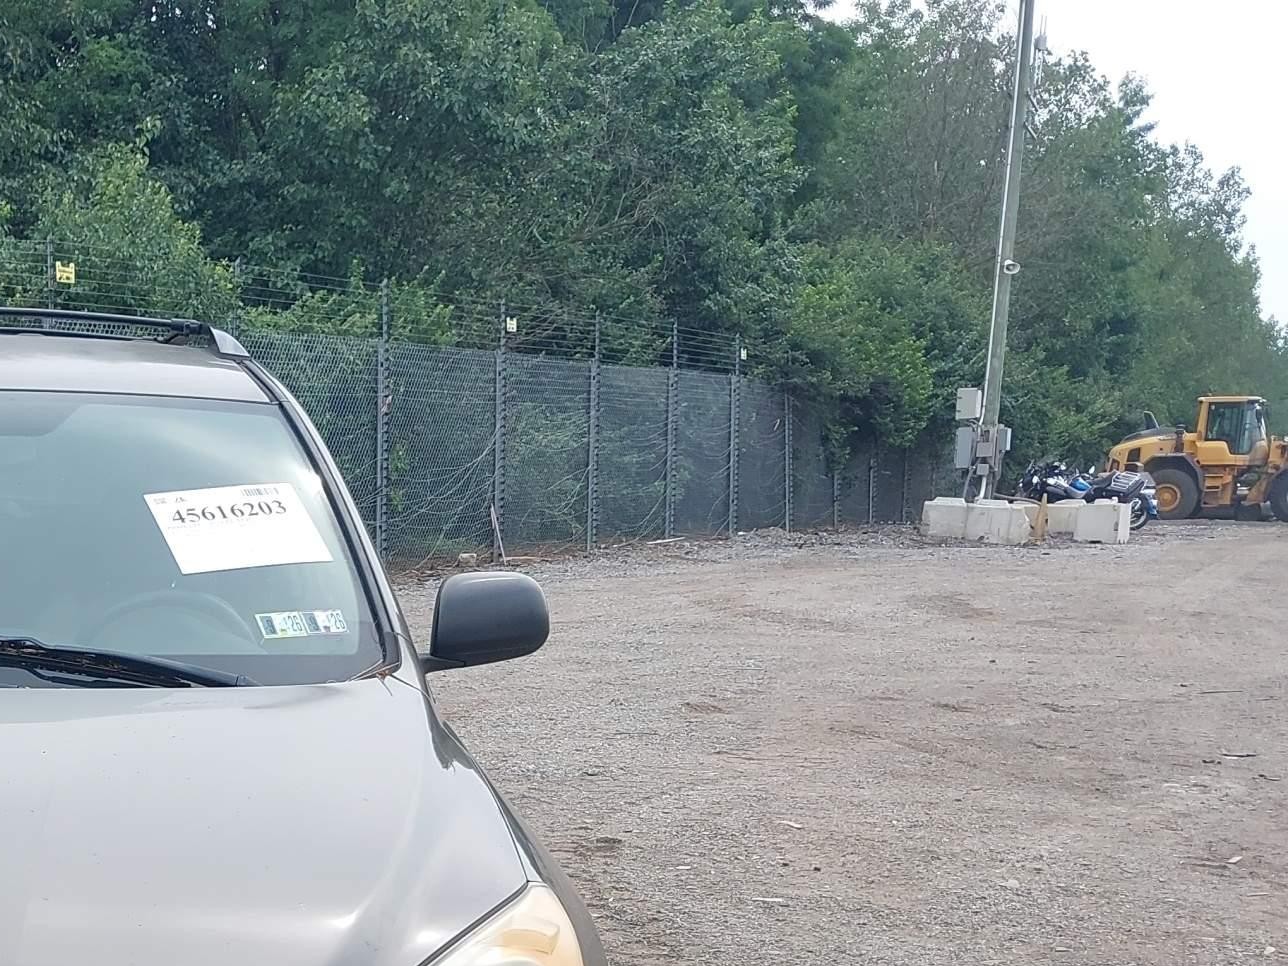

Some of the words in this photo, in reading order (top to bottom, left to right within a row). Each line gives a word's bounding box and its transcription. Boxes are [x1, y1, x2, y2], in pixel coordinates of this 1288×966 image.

[172, 499, 287, 524] 45616203
[287, 616, 303, 632] 26
[330, 612, 346, 630] 26
